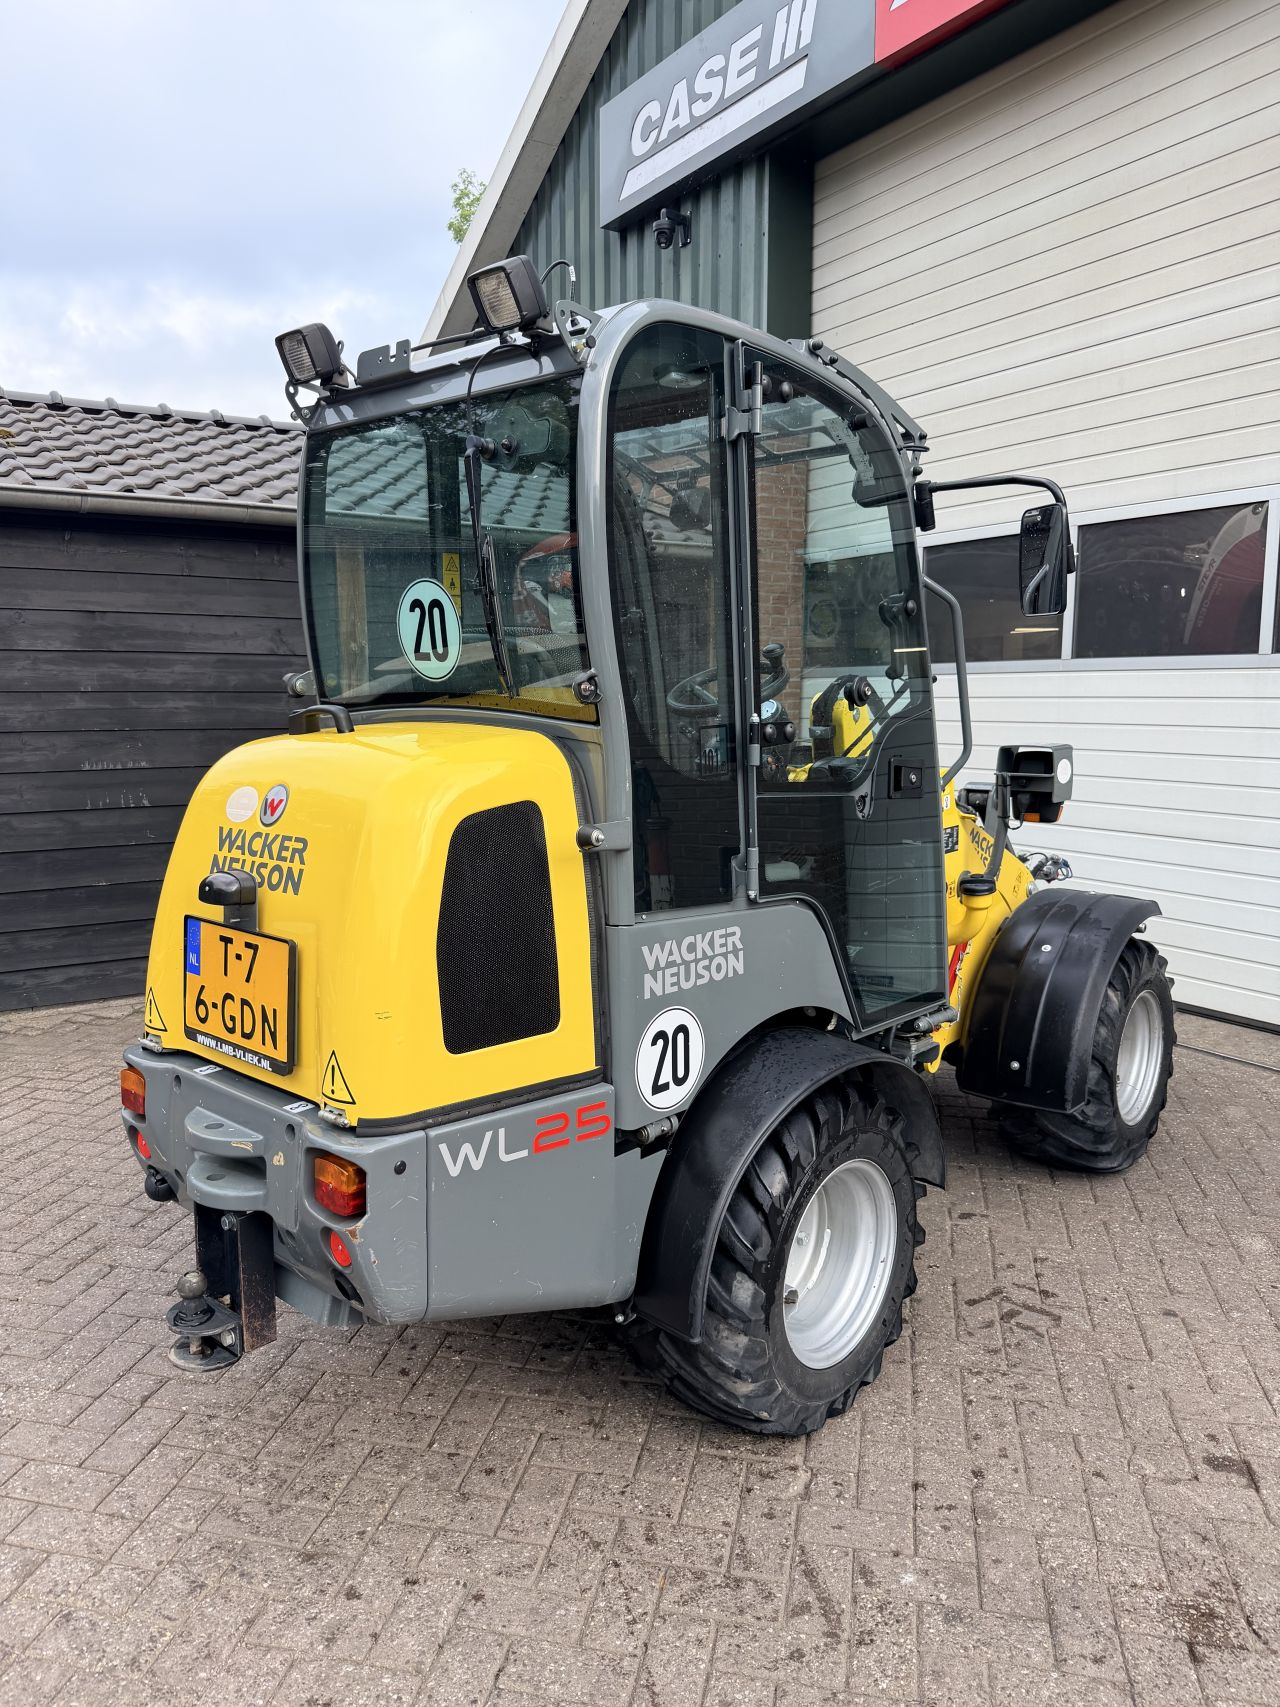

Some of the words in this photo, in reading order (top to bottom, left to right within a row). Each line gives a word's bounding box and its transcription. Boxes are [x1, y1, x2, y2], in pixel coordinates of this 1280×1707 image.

[630, 23, 763, 157] CASE
[409, 598, 449, 663] 20
[218, 826, 308, 865] WACKER
[189, 951, 199, 967] NL
[219, 935, 259, 983] T-7
[641, 926, 744, 971] WACKER
[643, 950, 744, 1000] NEUSON
[195, 985, 278, 1051] 6-GDN
[196, 1034, 273, 1071] WWW.LMB-VLIEK.NL
[650, 1023, 690, 1097] 20
